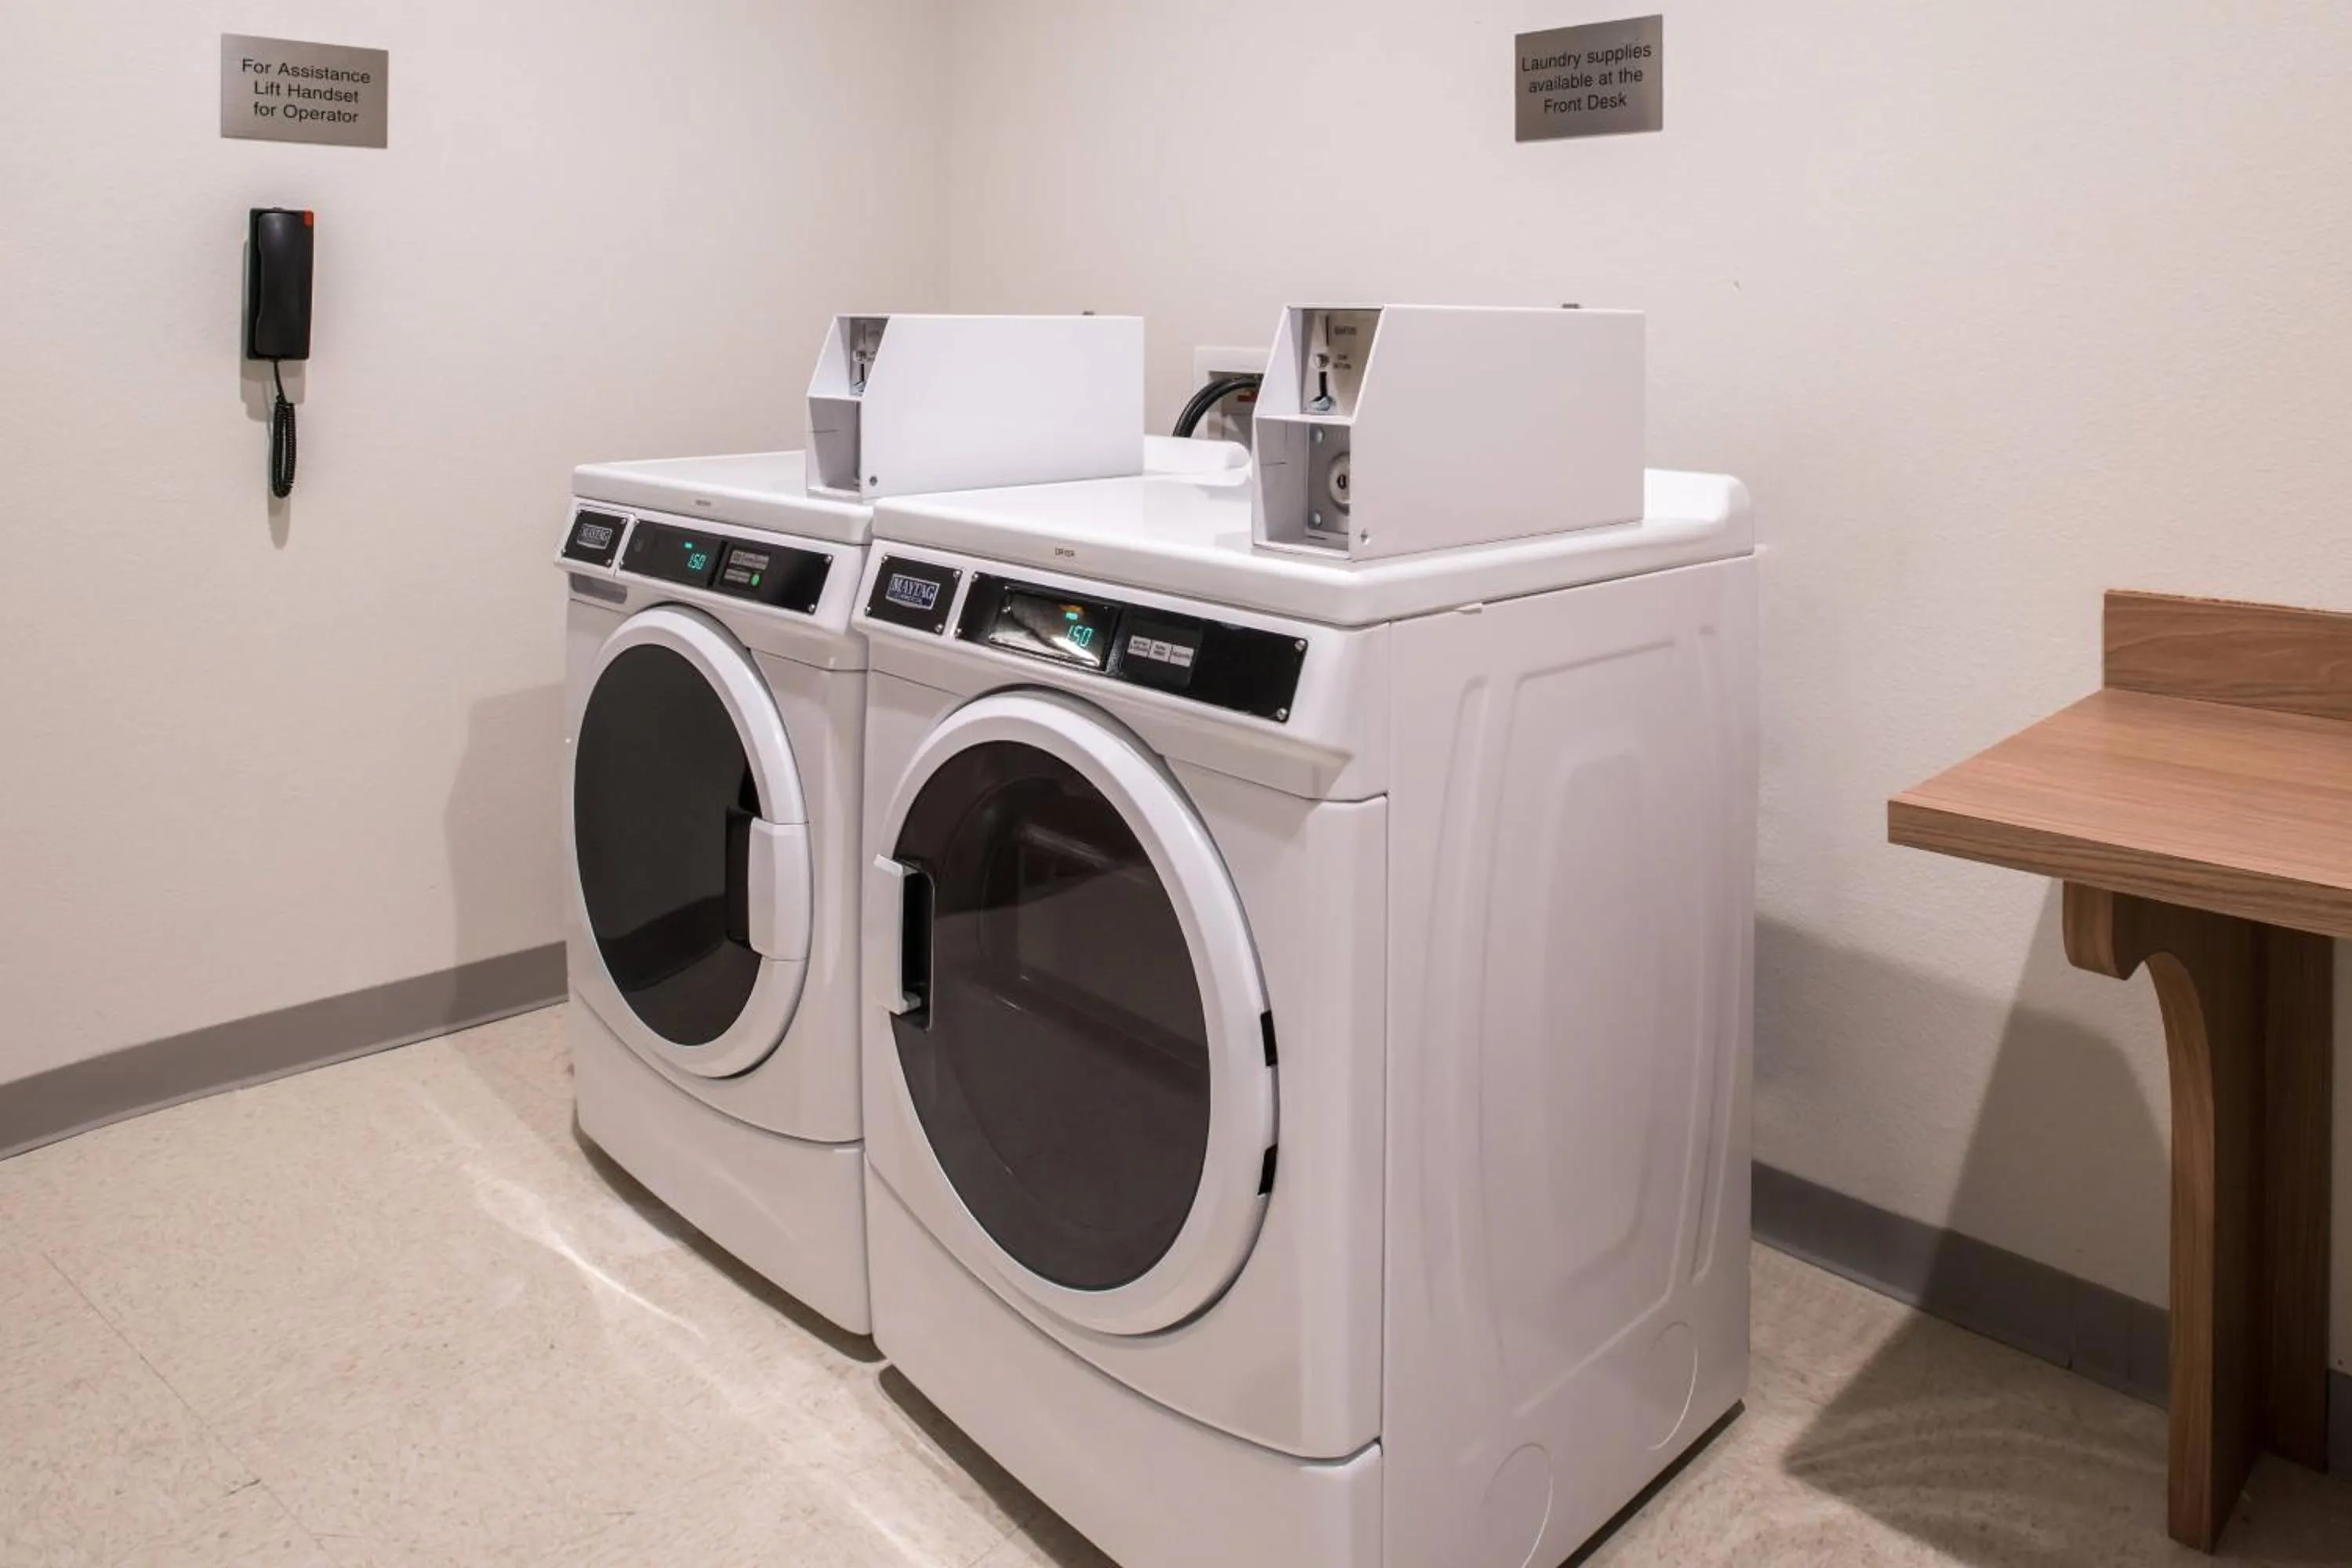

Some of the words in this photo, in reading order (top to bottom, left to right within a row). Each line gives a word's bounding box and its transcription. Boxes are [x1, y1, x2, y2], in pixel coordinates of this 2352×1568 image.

[1522, 54, 1581, 71] Laundry
[1587, 44, 1652, 65] supplies
[242, 59, 272, 74] For
[277, 63, 371, 84] Assistance
[1529, 73, 1593, 93] available
[1599, 72, 1613, 85] at
[1618, 67, 1643, 83] the
[254, 81, 281, 96] Lift
[287, 83, 359, 103] Handset
[1544, 97, 1582, 114] Front
[1587, 93, 1628, 110] Desk
[253, 101, 276, 117] for
[283, 104, 359, 123] Operator
[890, 577, 935, 600] MAYTAG
